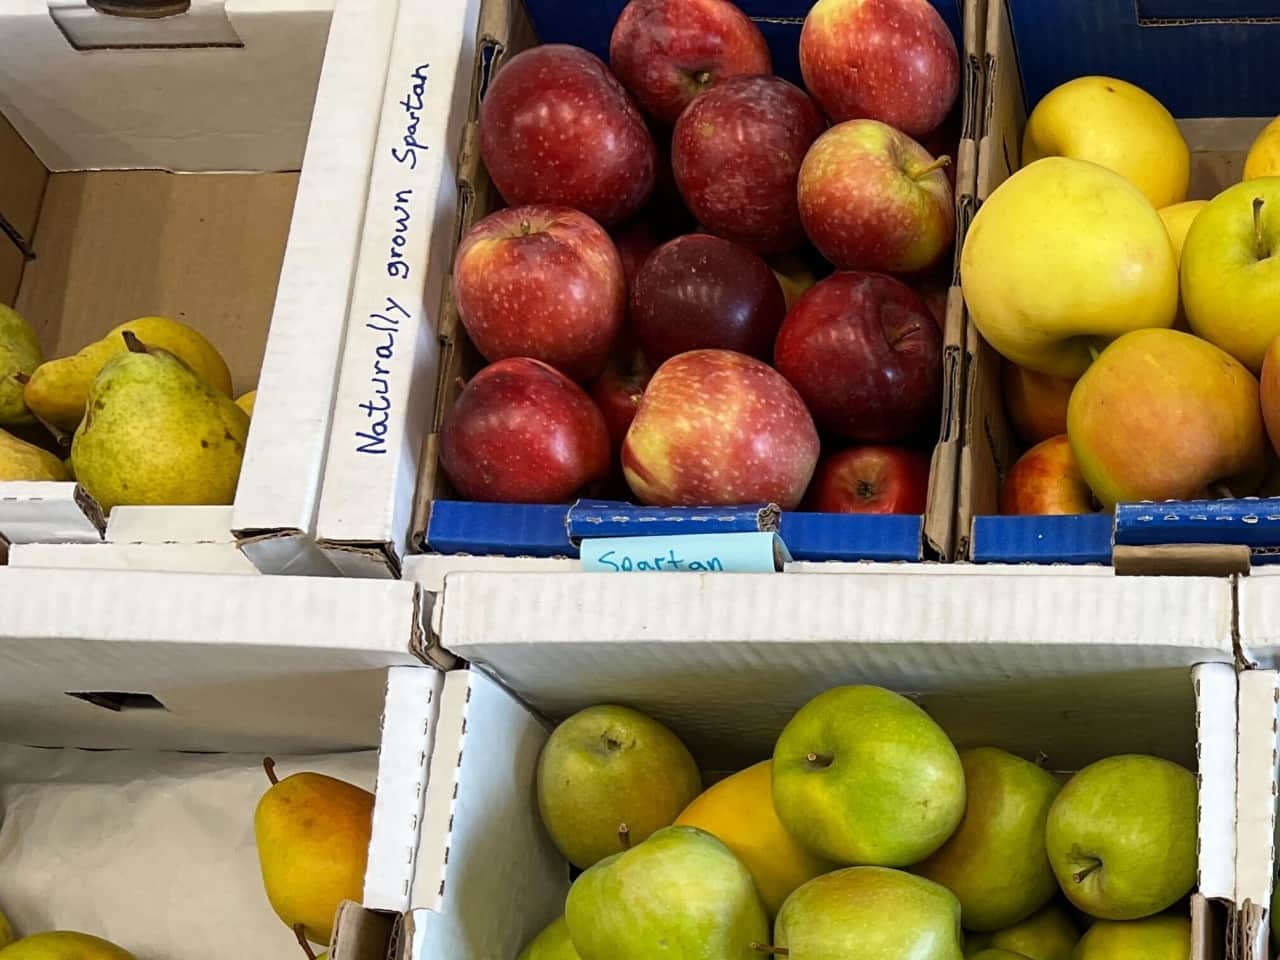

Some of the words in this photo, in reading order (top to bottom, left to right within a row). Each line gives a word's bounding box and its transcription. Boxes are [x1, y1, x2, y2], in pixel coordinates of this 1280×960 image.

[391, 63, 430, 170] Spartan
[387, 189, 413, 280] grown
[355, 297, 412, 456] Naturally
